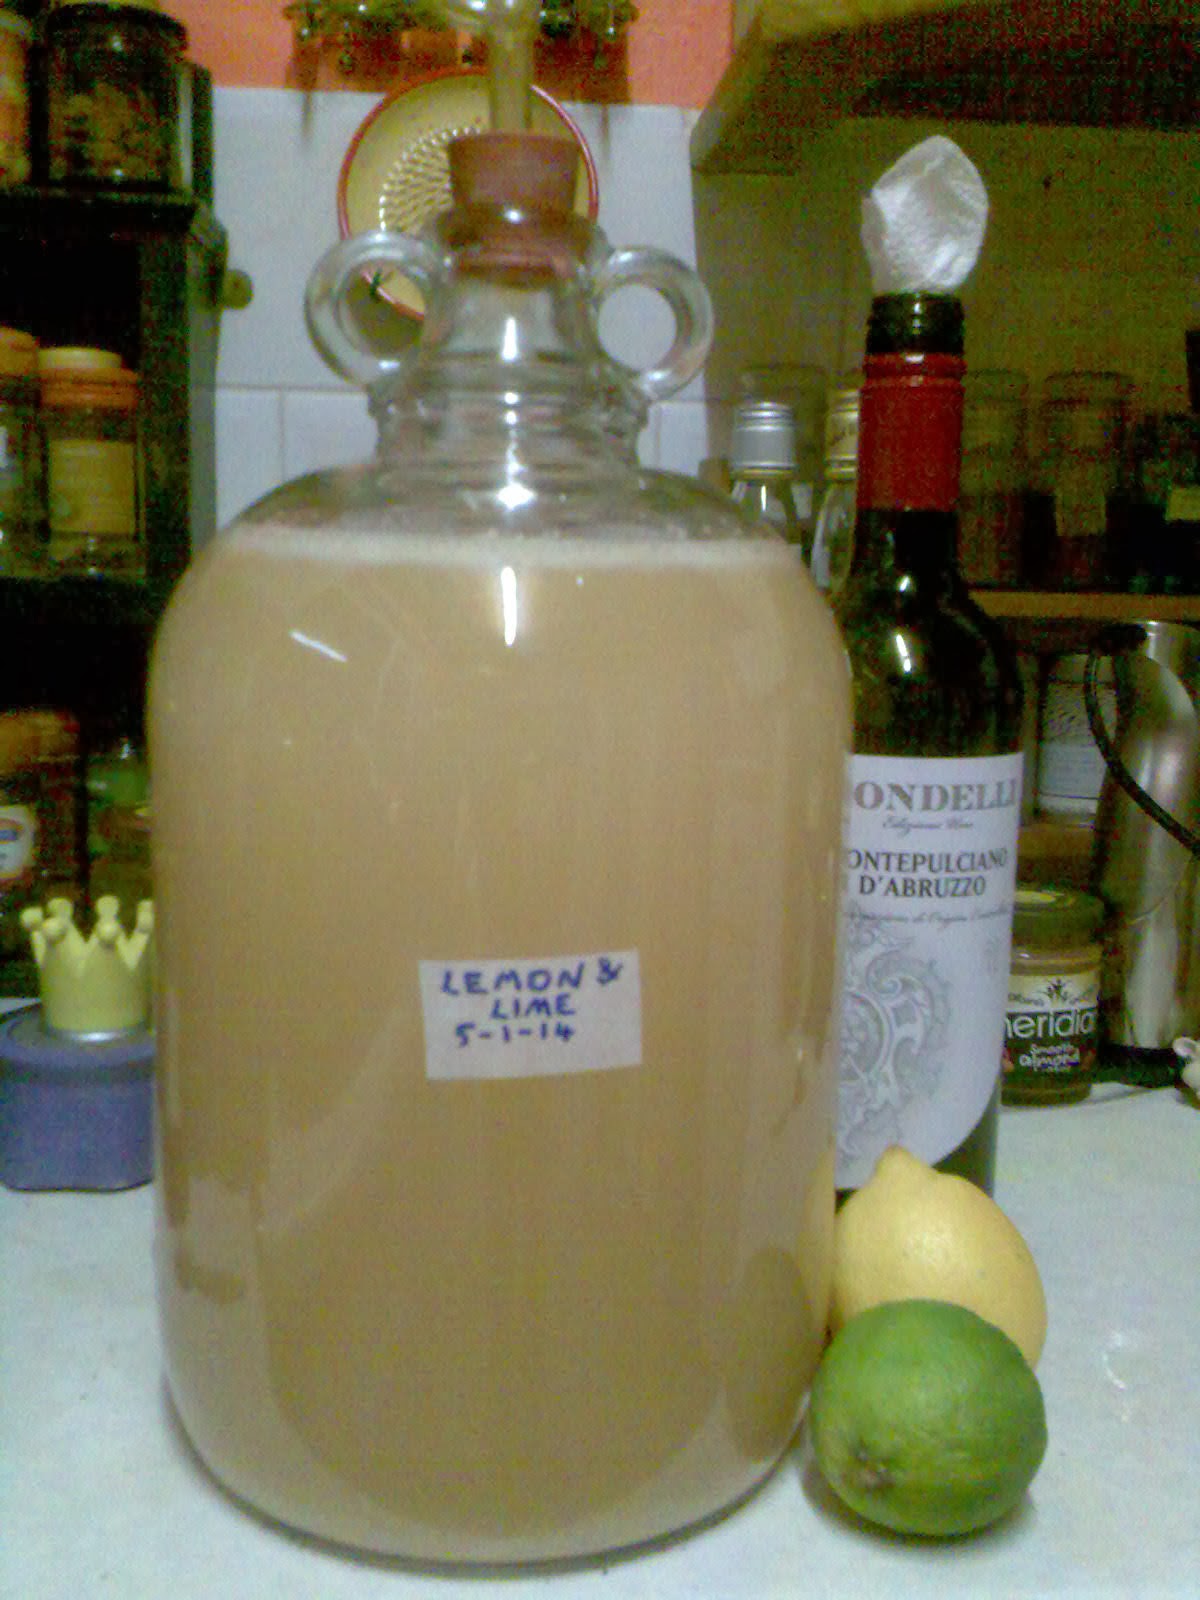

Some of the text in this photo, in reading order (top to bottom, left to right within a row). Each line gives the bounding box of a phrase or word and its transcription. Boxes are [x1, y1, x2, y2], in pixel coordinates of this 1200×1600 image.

[859, 875, 986, 898] D'ABRUZZO
[441, 957, 623, 996] LEMON &
[490, 993, 576, 1020] LIME
[455, 1021, 576, 1048] 5-1-14
